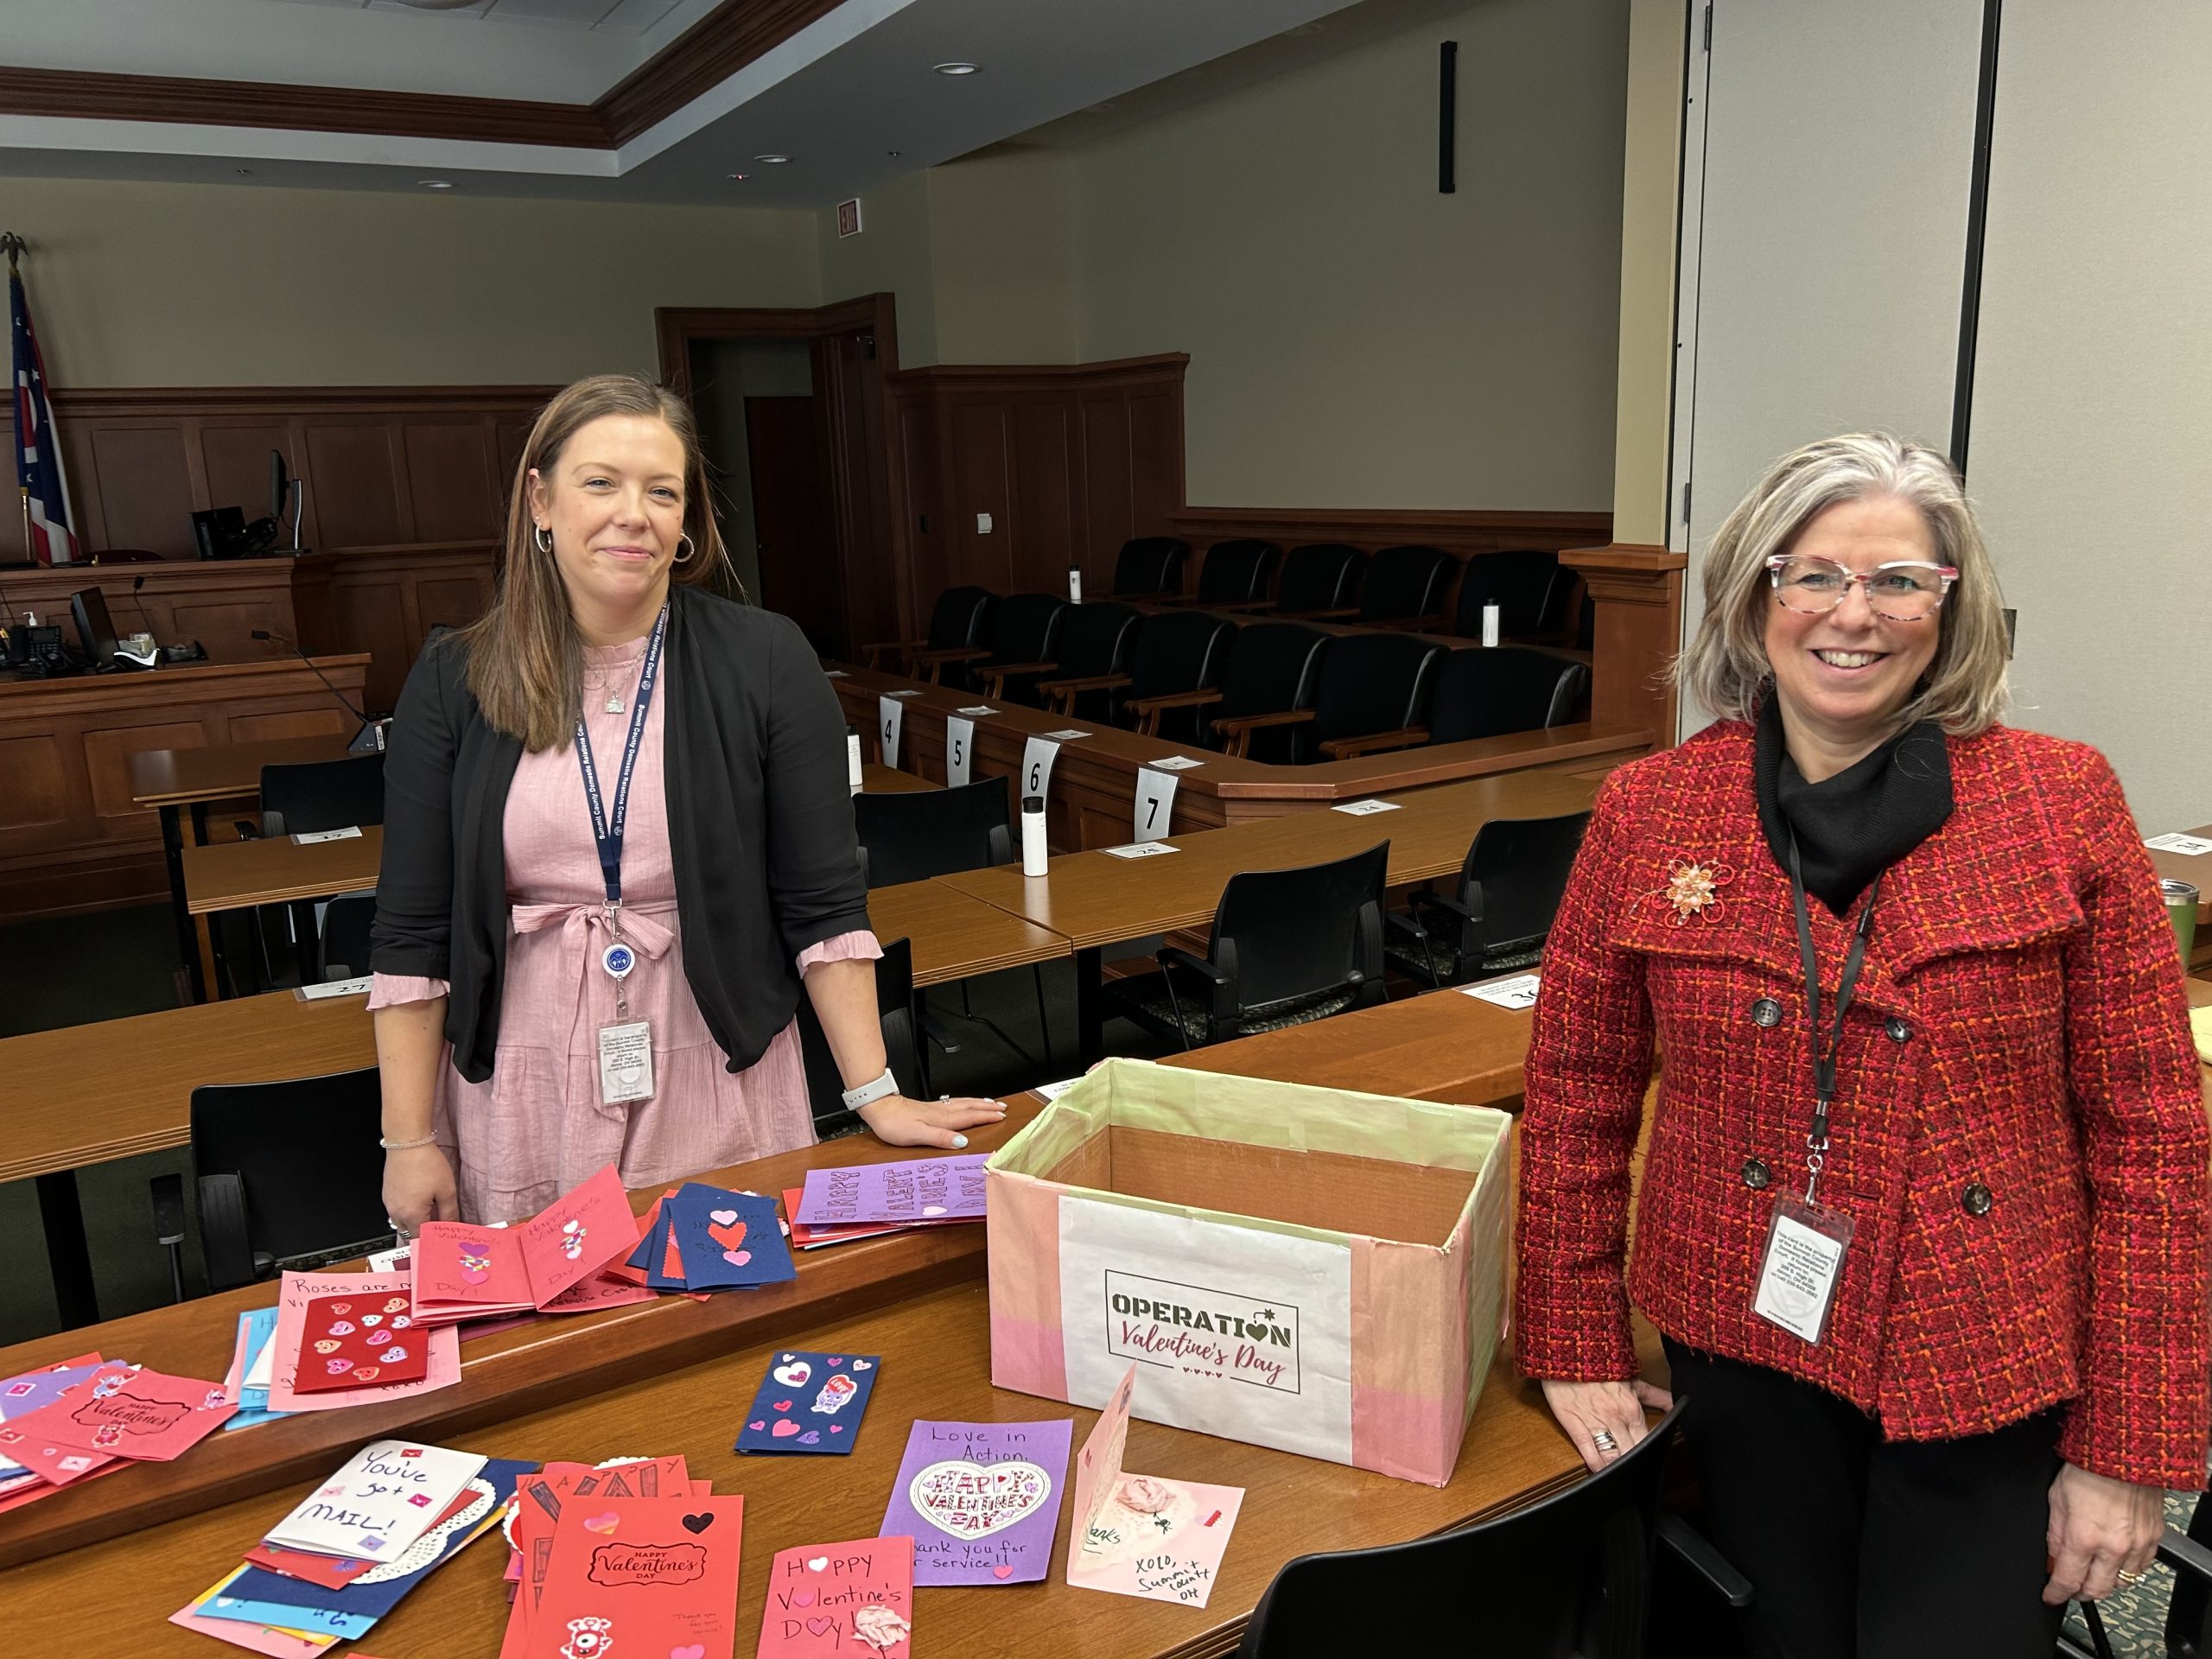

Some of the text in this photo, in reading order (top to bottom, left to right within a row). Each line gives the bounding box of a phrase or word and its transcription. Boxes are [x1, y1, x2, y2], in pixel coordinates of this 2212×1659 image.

[885, 719, 893, 744] 4
[580, 737, 589, 765] Relations
[954, 740, 962, 766] 5
[585, 765, 596, 792] Domestic
[1030, 763, 1040, 791] 6
[589, 793, 599, 815] County
[1146, 798, 1159, 830] 7
[290, 1279, 352, 1294] Roses
[1122, 1320, 1286, 1385] Valentine's Day
[93, 1401, 169, 1426] Valentine's
[931, 1427, 1026, 1442] Love in
[359, 1451, 430, 1484] You've
[356, 1483, 404, 1497] got
[931, 1470, 1036, 1495] HAPPY
[923, 1491, 1034, 1512] VALENTINE'S
[298, 1503, 397, 1536] MAIL!
[950, 1510, 1000, 1531] DAY
[963, 1546, 992, 1560] you
[1000, 1540, 1027, 1553] for
[599, 1555, 698, 1573] Valentine's
